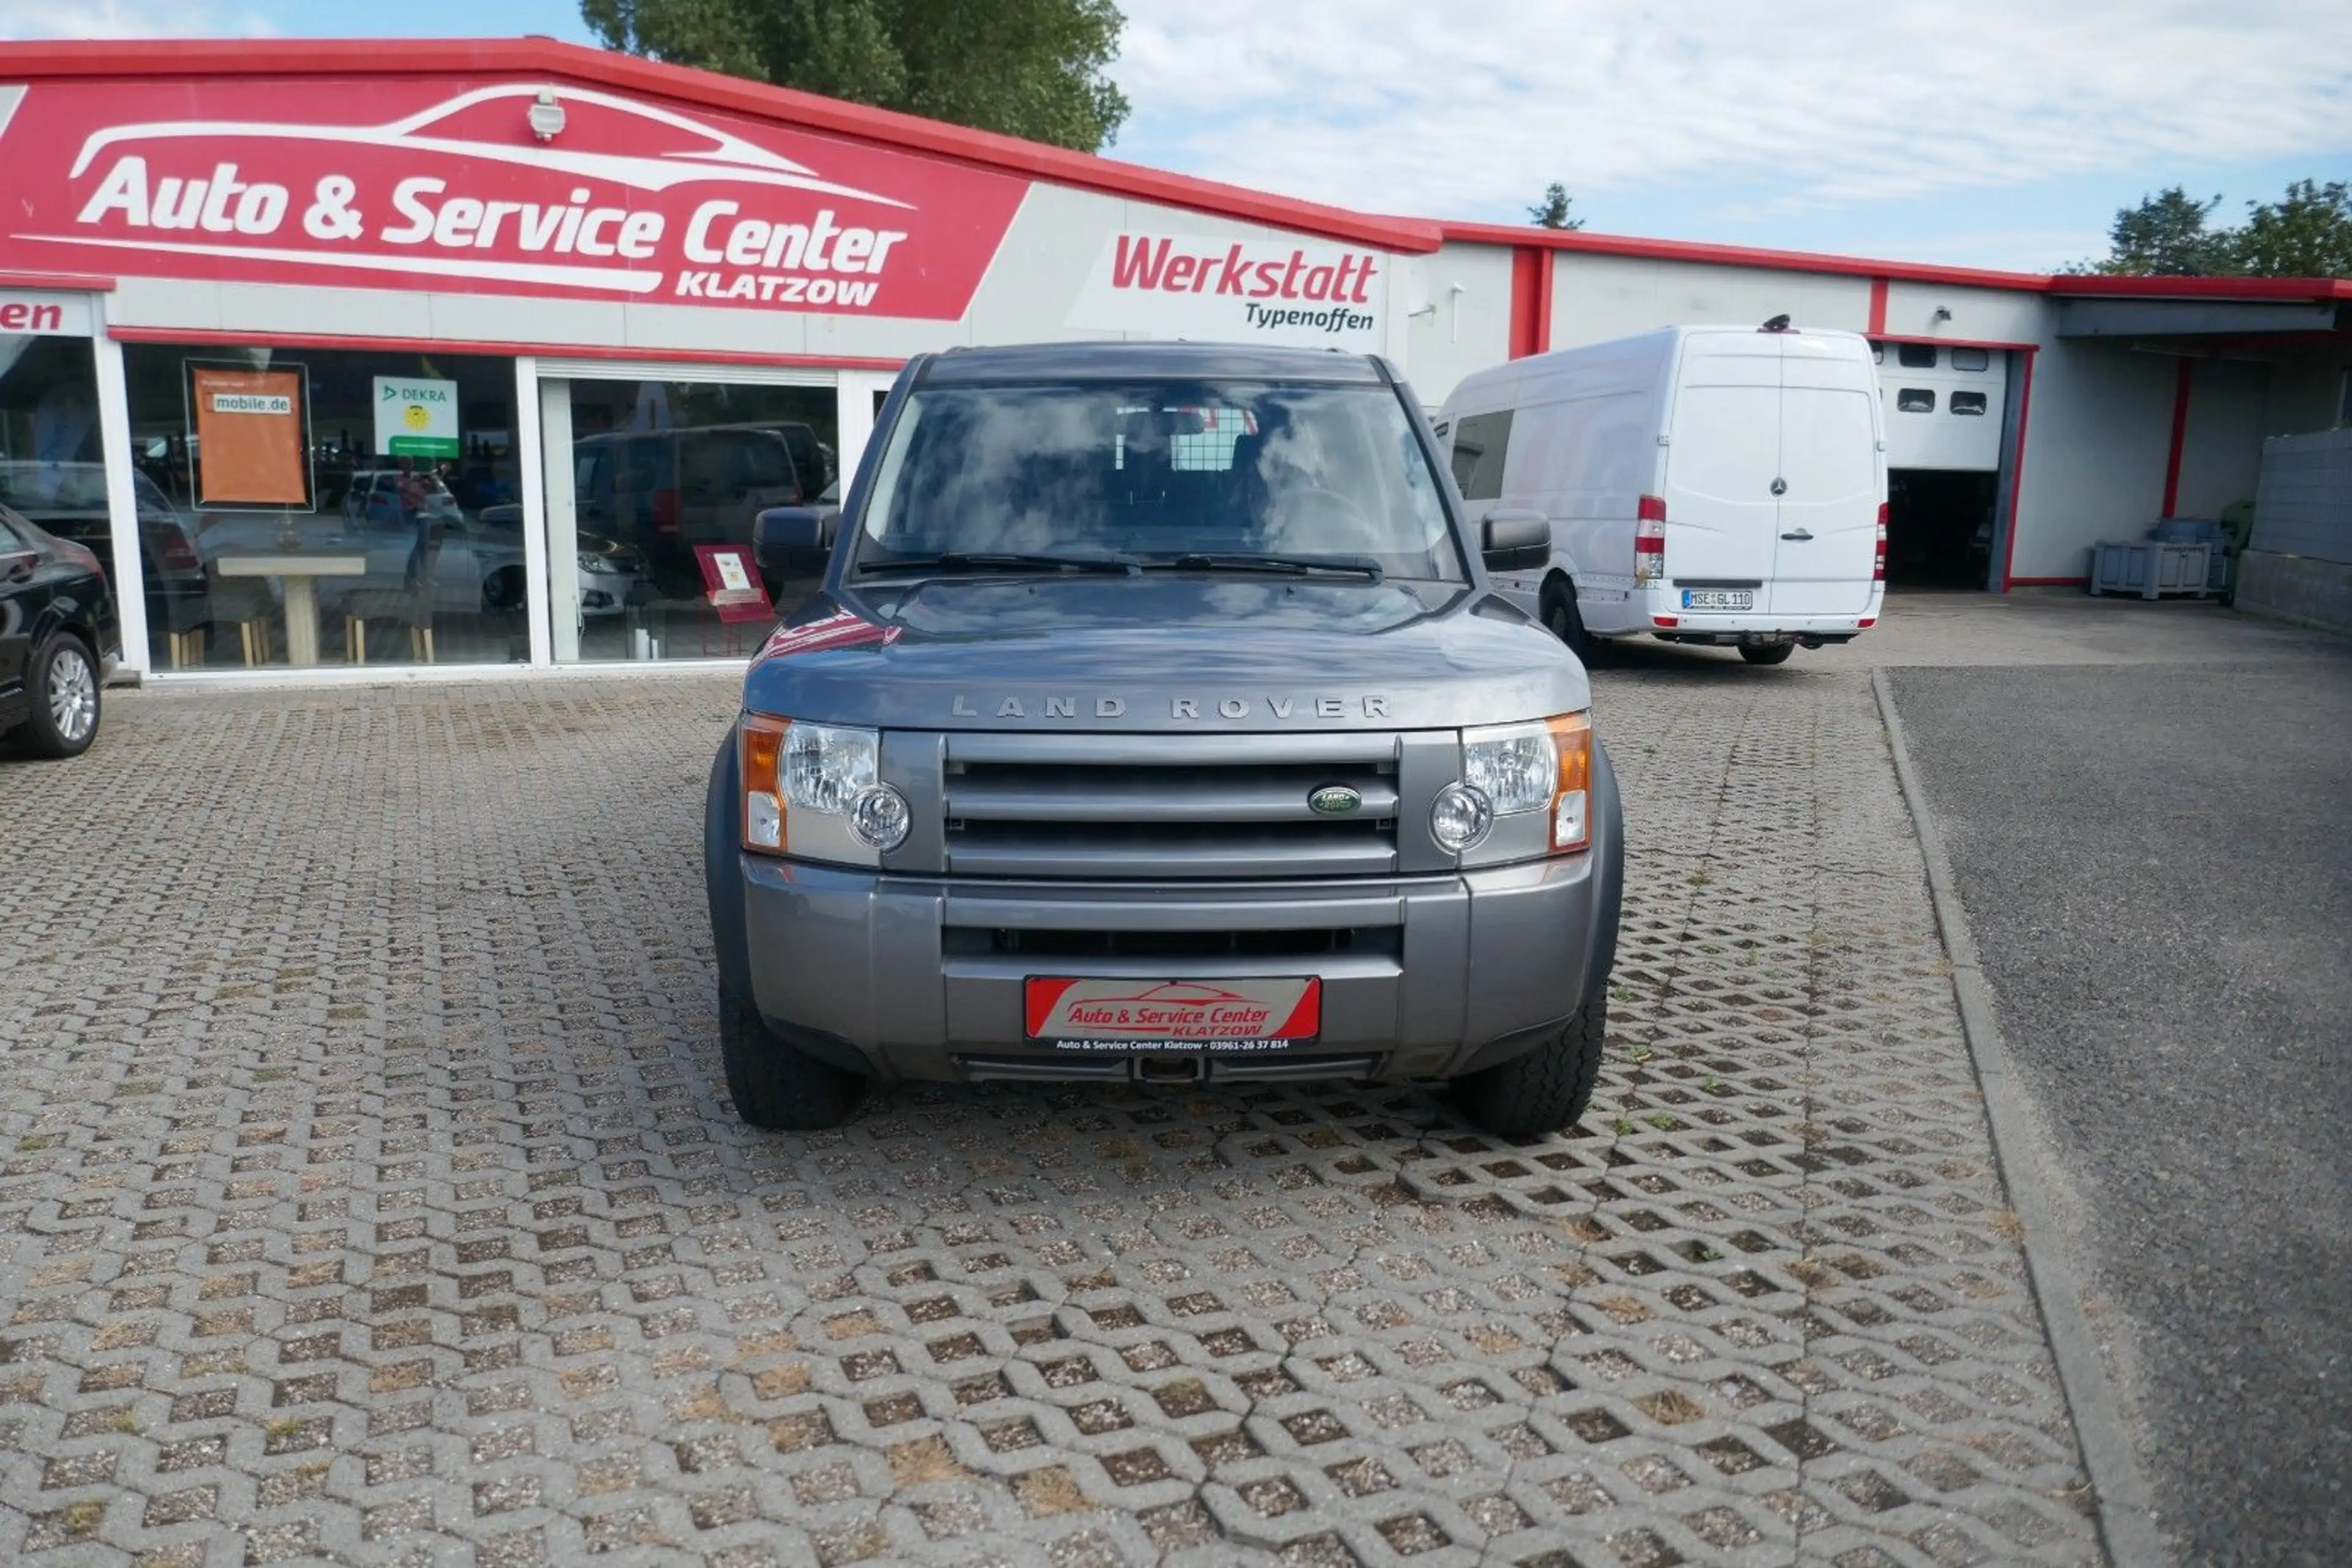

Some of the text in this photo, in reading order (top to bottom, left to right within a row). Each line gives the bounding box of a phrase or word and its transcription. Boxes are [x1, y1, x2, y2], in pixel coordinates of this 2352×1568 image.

[77, 157, 908, 274] Auto & Service Center
[1112, 235, 1378, 303] Werkstatt
[676, 271, 879, 306] KLATZOW
[0, 304, 62, 330] en
[1245, 303, 1374, 332] Typenoffen
[217, 397, 288, 410] mobile.de
[402, 388, 447, 402] DEKRA
[1691, 593, 1709, 605] MSE
[952, 696, 1392, 718] LAND ROVER
[1068, 1008, 1270, 1023] Auto & Service Center
[1172, 1025, 1262, 1036] KLATZOW
[1057, 1040, 1080, 1049] Auto
[1082, 1040, 1091, 1049] &
[1093, 1041, 1128, 1050] Service
[1129, 1041, 1163, 1050] Center
[1164, 1041, 1202, 1050] Klatzow
